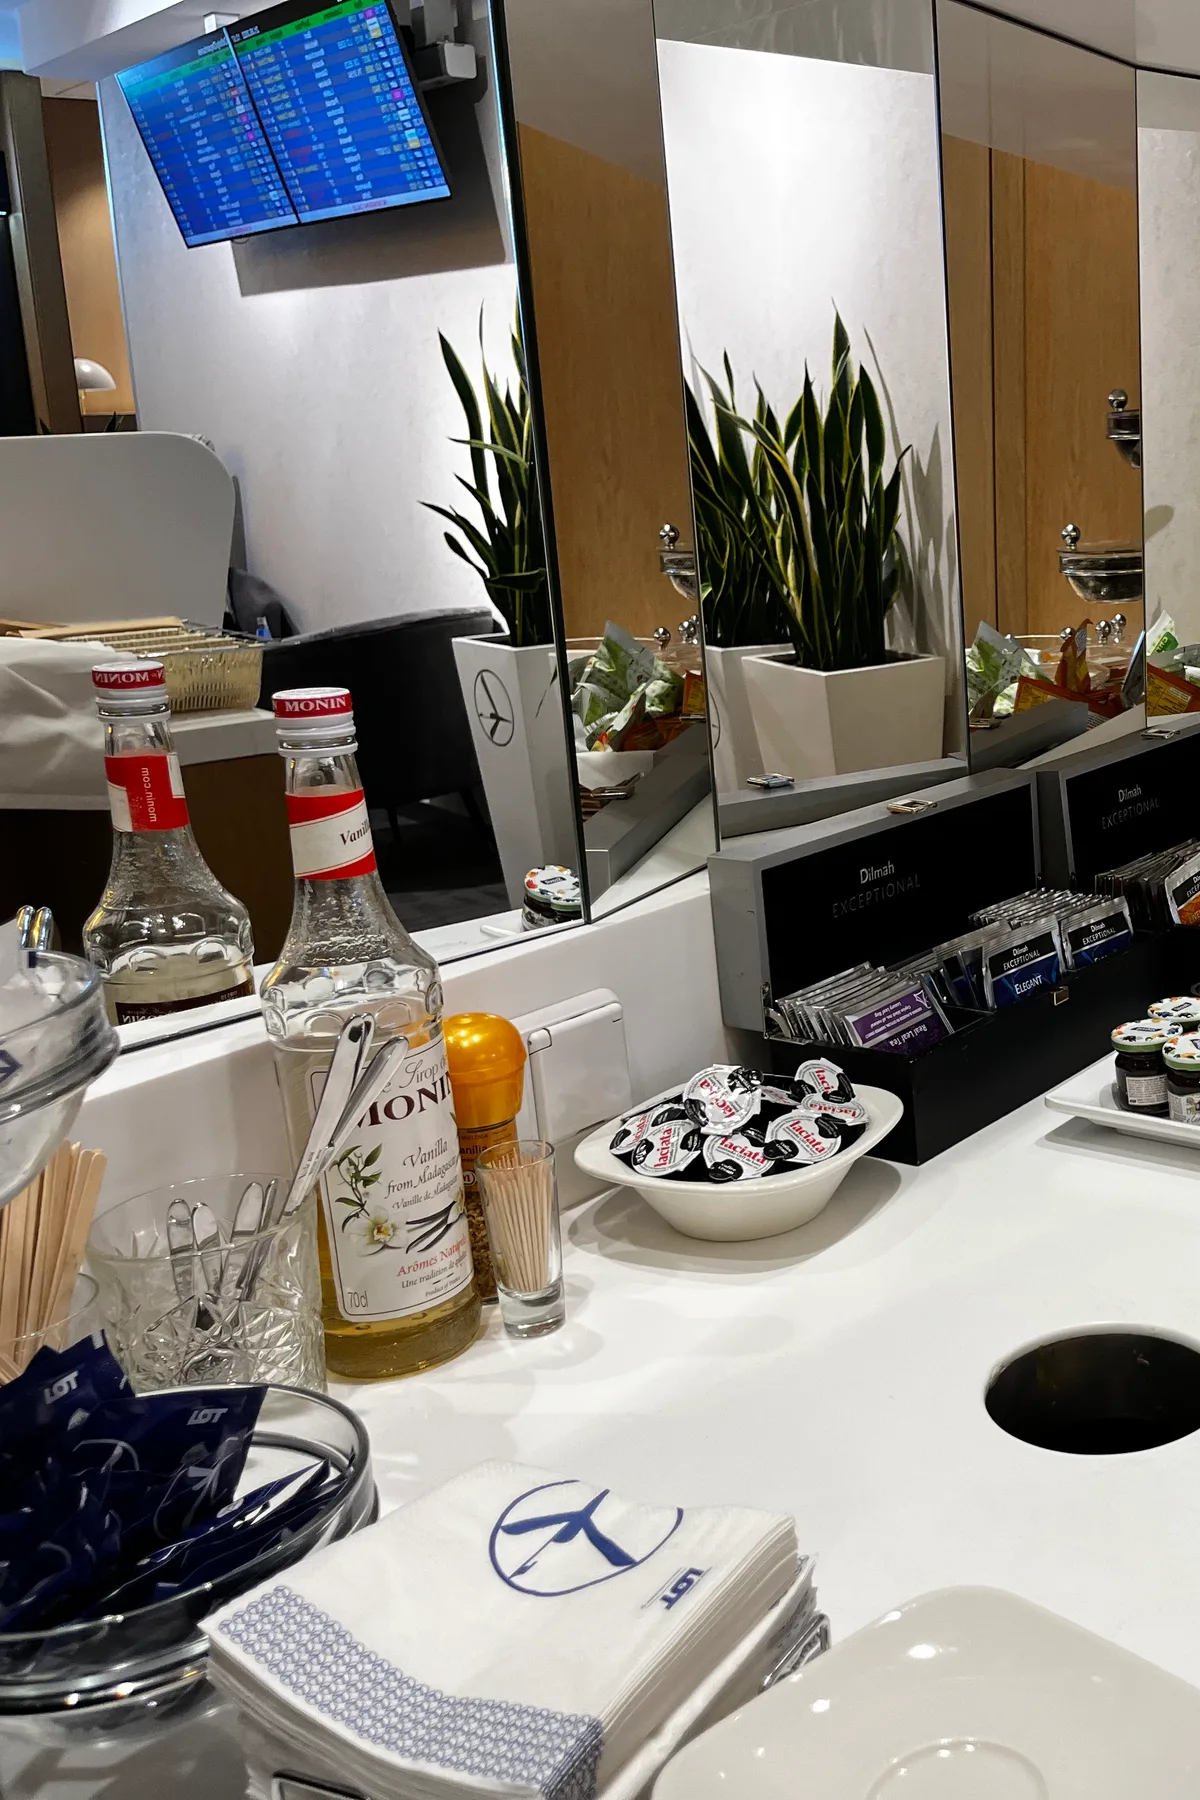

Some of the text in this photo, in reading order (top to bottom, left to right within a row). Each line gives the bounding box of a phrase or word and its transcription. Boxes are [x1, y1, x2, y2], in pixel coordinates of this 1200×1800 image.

[285, 697, 346, 712] MONIN
[1118, 784, 1142, 802] Dilmah
[1101, 798, 1159, 830] EXCEPTIONAL
[340, 818, 372, 846] Vanill
[860, 861, 895, 884] Dilmah
[832, 874, 921, 918] EXCEPTIONAL
[1082, 927, 1116, 945] EXCEPTIONAL
[1003, 950, 1040, 970] EXCEPTIONAL
[1014, 975, 1043, 995] ELEGANT
[913, 1023, 928, 1036] Real
[889, 1037, 902, 1047] Tea
[399, 1060, 438, 1089] Sirop
[403, 1138, 448, 1168] Vanilla
[384, 1180, 413, 1199] from
[392, 1191, 422, 1210] Vanille
[396, 1255, 438, 1277] Arômes
[401, 1279, 417, 1289] Une
[419, 1267, 448, 1283] tradition
[347, 1290, 368, 1308] 70cl
[44, 1370, 79, 1405] LOT
[187, 1408, 228, 1426] LOT
[661, 1567, 704, 1611] LOT
